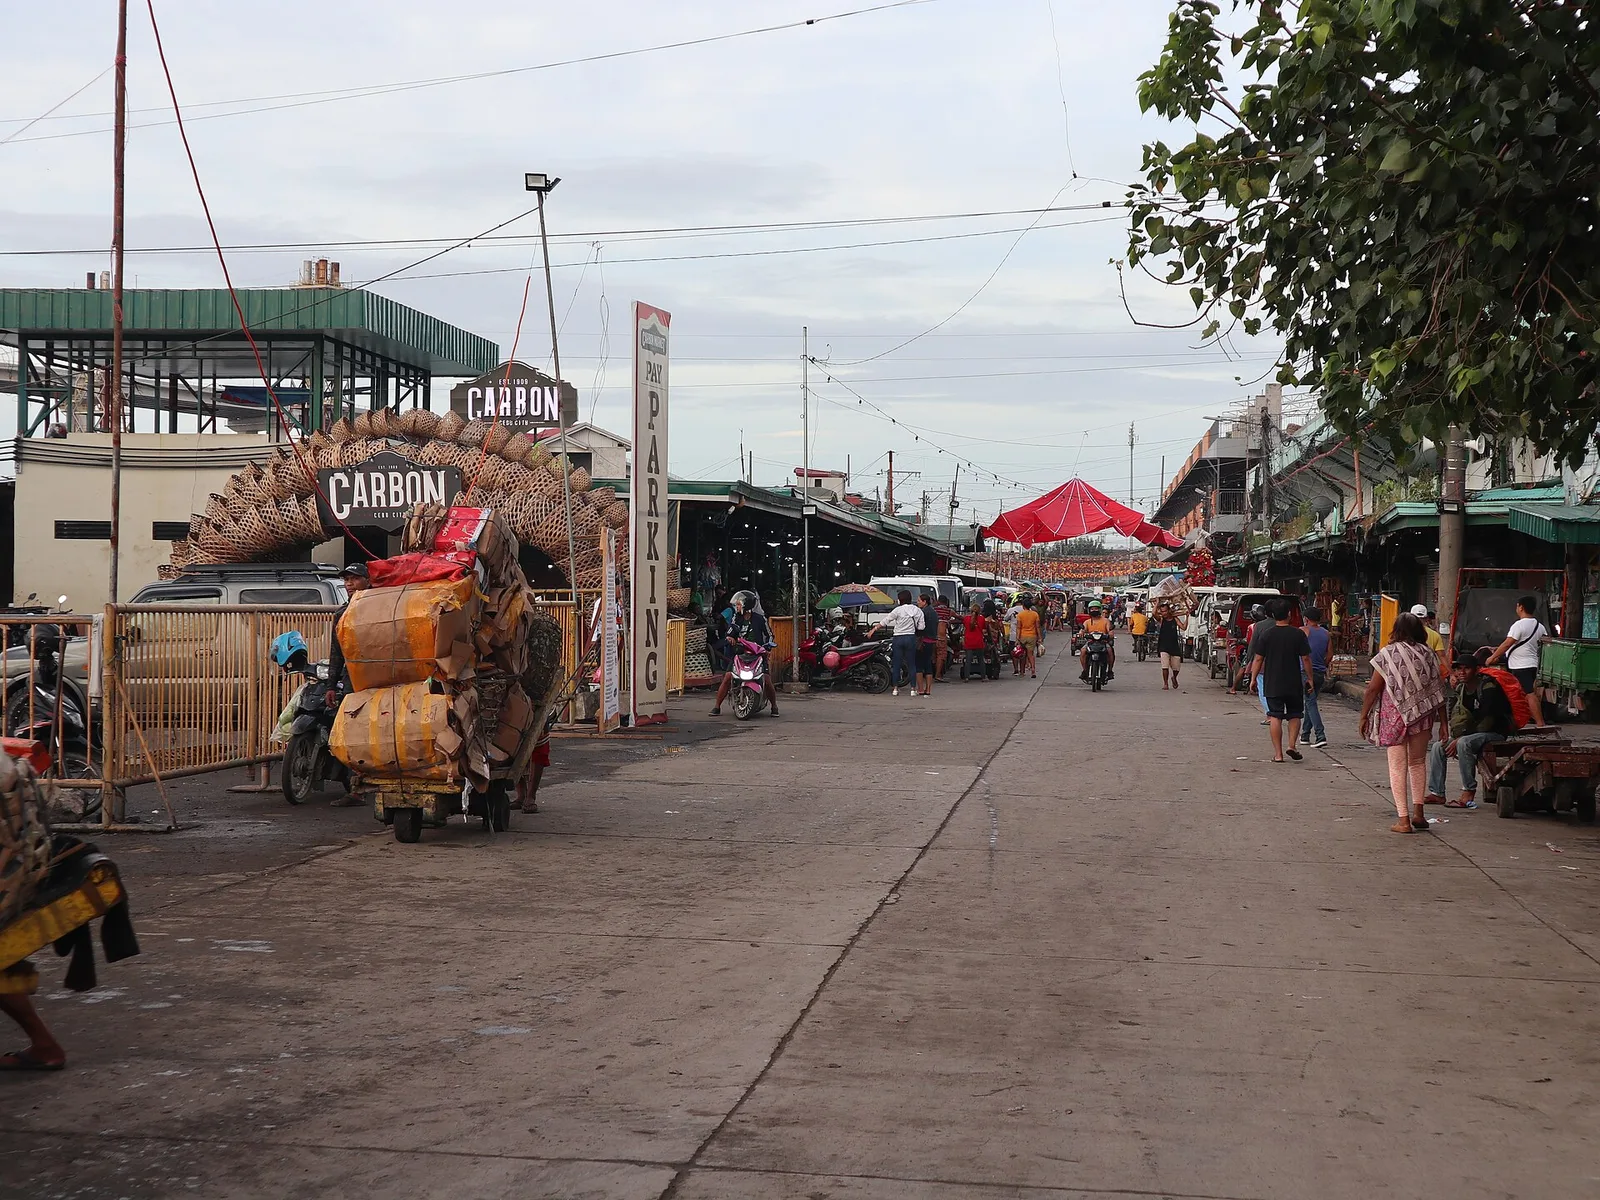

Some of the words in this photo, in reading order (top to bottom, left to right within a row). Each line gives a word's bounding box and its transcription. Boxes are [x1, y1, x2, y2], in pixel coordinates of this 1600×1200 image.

[645, 360, 662, 384] PAY
[467, 386, 559, 421] CARBON
[328, 470, 446, 520] CARBON
[645, 391, 661, 692] PARKING
